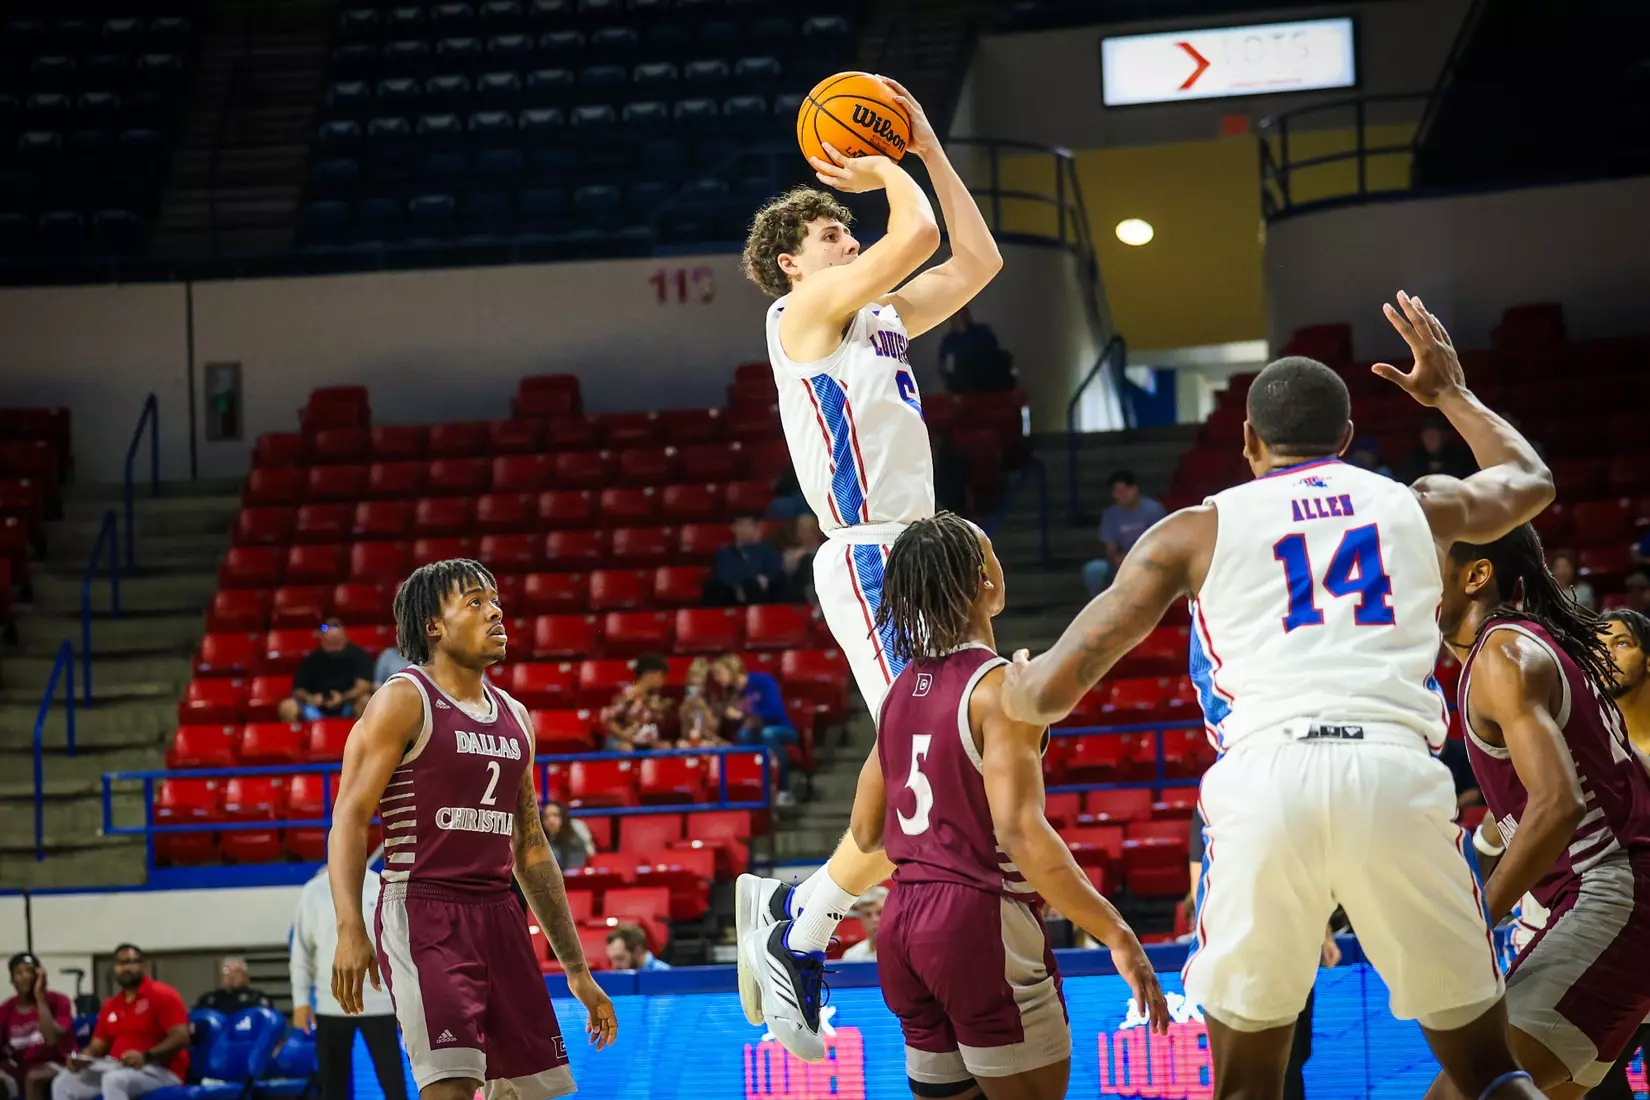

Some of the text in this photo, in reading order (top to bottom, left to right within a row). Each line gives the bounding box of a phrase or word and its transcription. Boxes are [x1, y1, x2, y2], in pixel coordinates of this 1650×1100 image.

[852, 104, 906, 153] Wilson
[1291, 493, 1355, 522] ALLEN
[1272, 522, 1397, 634] 14
[454, 730, 522, 760] DALLAS
[479, 760, 501, 806] 2
[896, 734, 934, 836] 5
